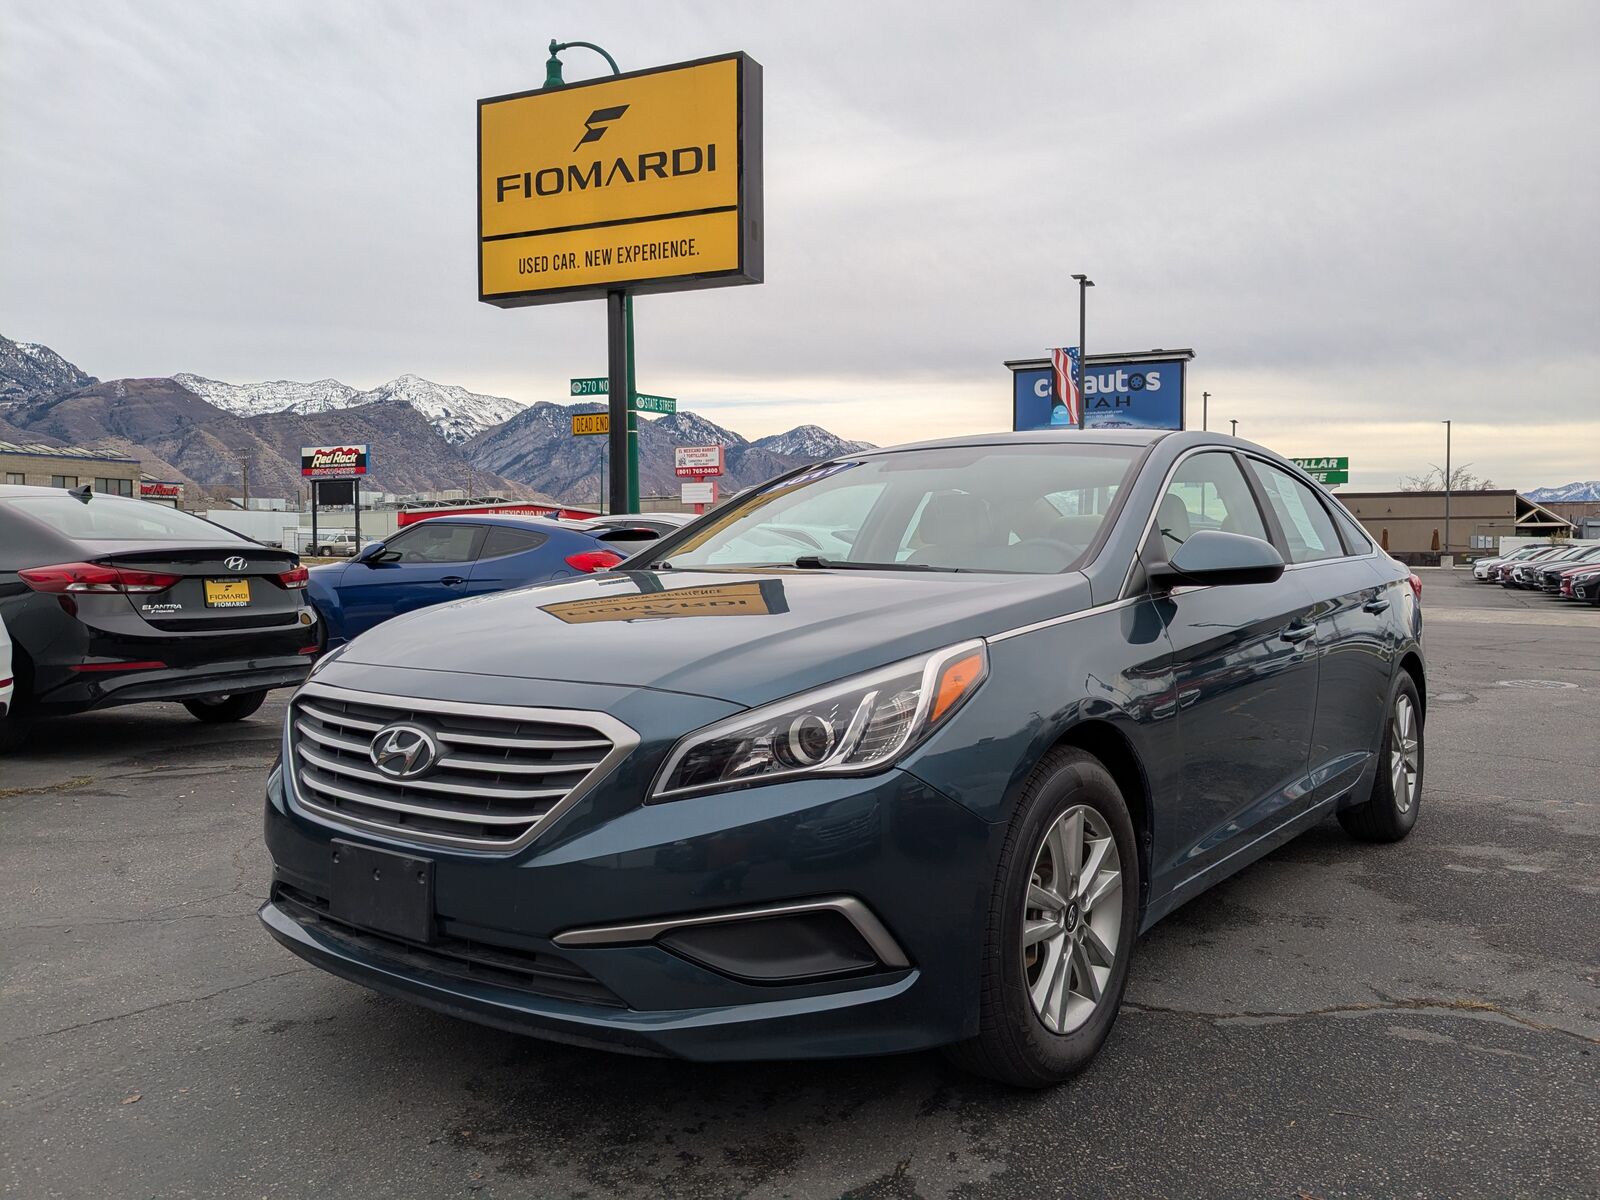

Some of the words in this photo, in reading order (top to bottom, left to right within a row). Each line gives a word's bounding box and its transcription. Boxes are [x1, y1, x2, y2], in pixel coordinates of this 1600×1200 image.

[497, 143, 716, 203] FIOMARDI
[519, 255, 549, 275] USED
[553, 253, 580, 271] CAR.
[585, 248, 613, 268] NEW
[617, 238, 700, 264] EXPERIENCE.
[582, 381, 597, 393] 570
[599, 380, 609, 392] NO
[644, 397, 658, 410] STATE
[659, 399, 676, 412] STREET
[1084, 395, 1131, 409] TAH
[576, 417, 593, 432] DEAD
[596, 416, 608, 431] END
[311, 454, 334, 468] Red
[333, 451, 358, 463] Rock
[1294, 459, 1338, 469] OLLAR
[1311, 472, 1328, 482] EE
